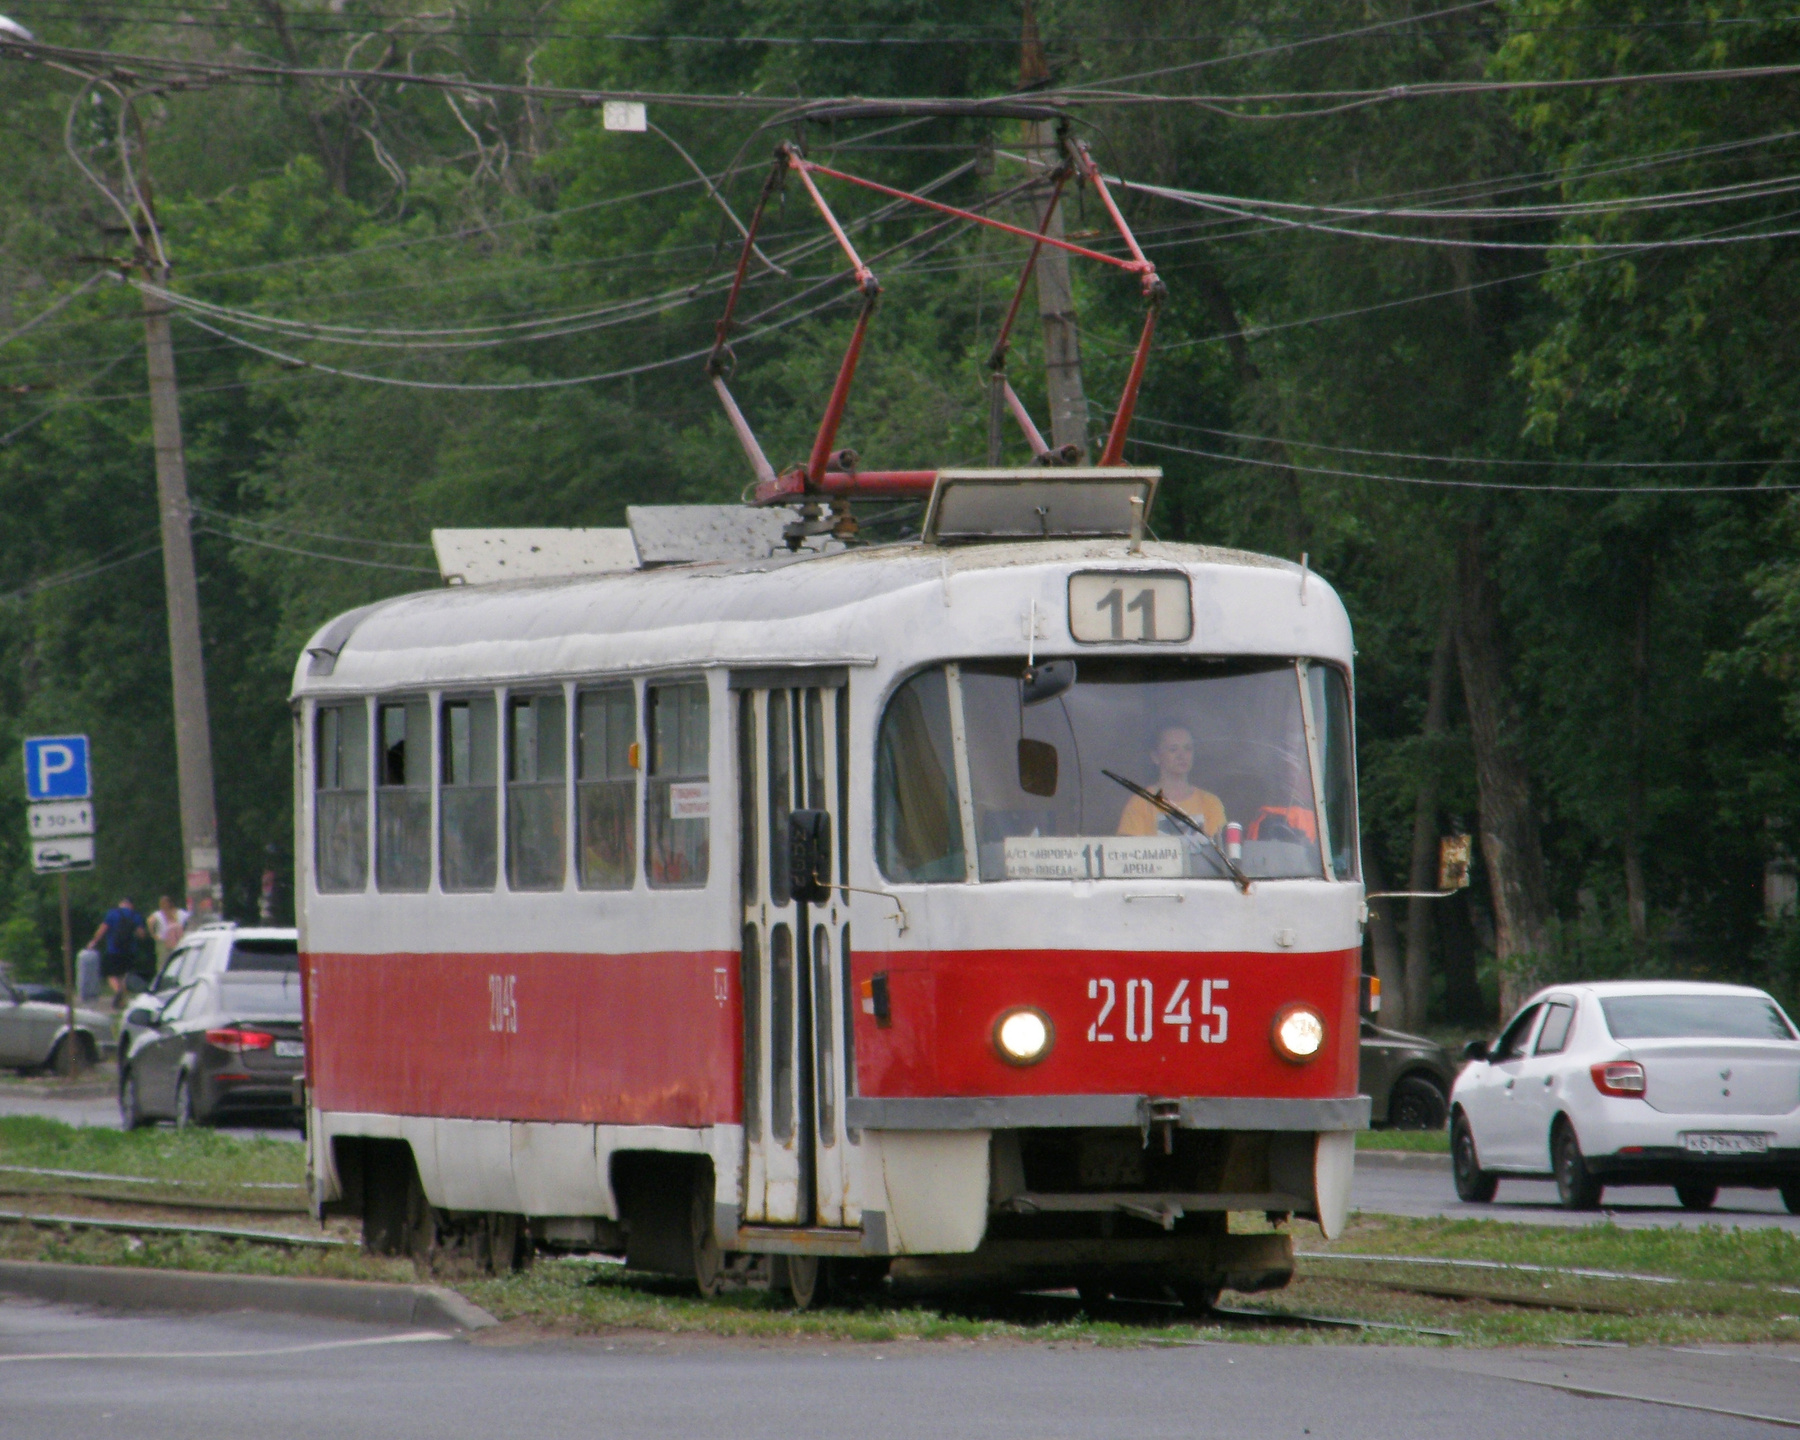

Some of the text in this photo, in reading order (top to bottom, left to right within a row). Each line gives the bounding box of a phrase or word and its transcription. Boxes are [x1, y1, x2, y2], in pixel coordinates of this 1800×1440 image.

[1096, 588, 1157, 641] 11
[39, 743, 74, 794] P
[1082, 844, 1106, 878] 11
[487, 972, 518, 1034] 2045
[1087, 978, 1230, 1043] 2045
